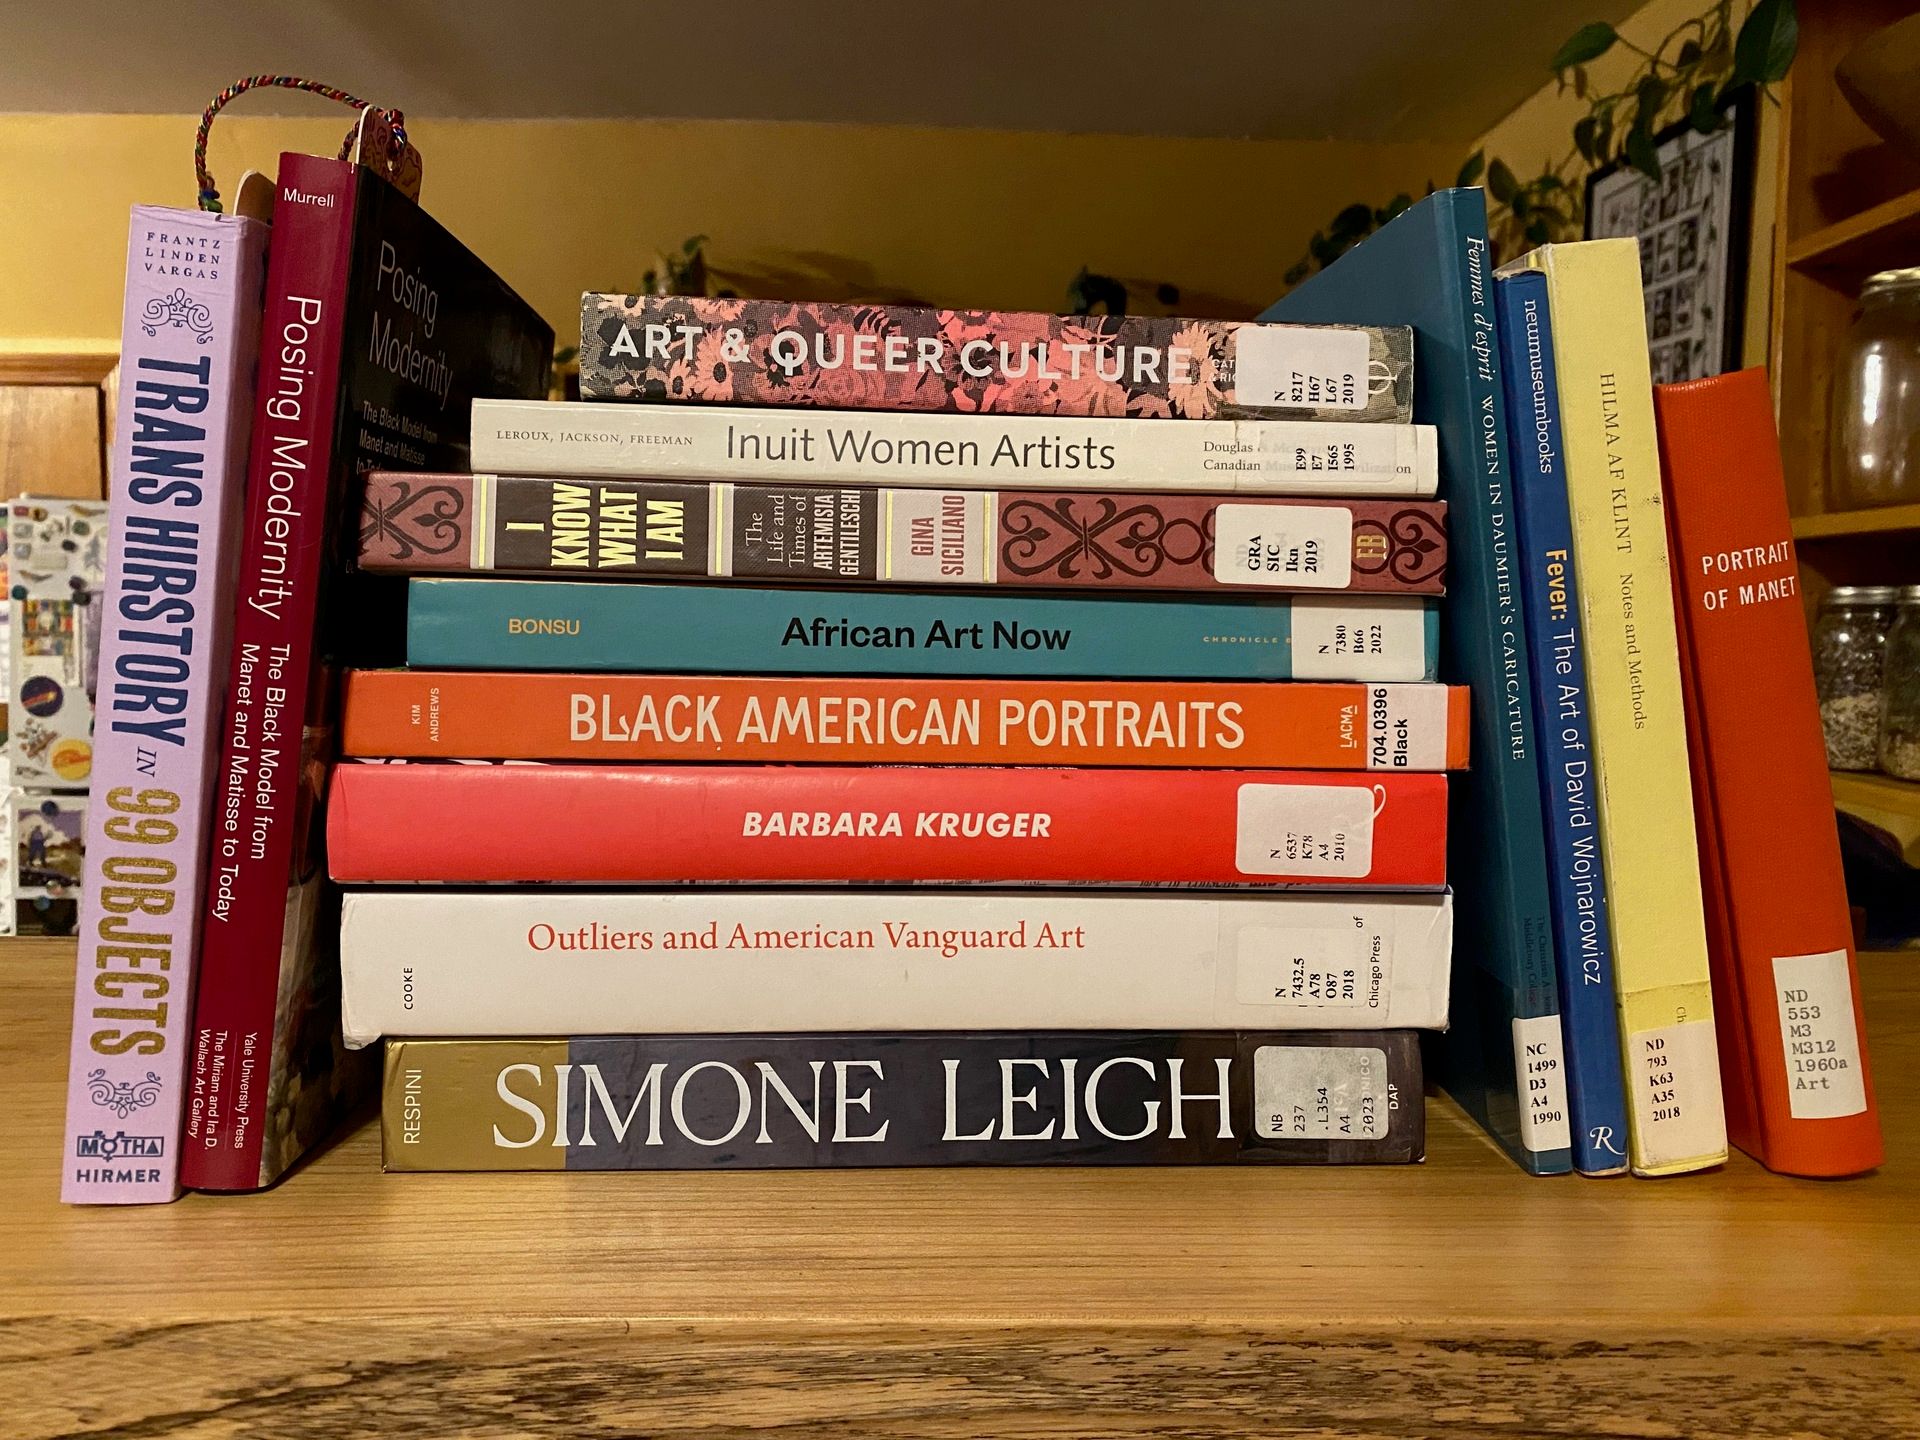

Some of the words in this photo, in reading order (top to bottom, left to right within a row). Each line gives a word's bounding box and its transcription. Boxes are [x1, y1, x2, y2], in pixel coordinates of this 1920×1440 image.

[284, 187, 334, 208] Murrell
[145, 247, 220, 265] LINDEN
[146, 231, 220, 250] FRANTZ
[144, 262, 219, 280] VARGAS
[1466, 236, 1484, 306] Femmes
[377, 240, 438, 338] Posing
[266, 295, 322, 421] Posing
[369, 311, 453, 411] Modernity
[609, 323, 702, 361] ART
[720, 328, 751, 362] &
[771, 331, 944, 376] QUEER
[961, 340, 1192, 384] CULTURE
[1472, 312, 1496, 382] d'esprit
[1291, 371, 1304, 402] 8217
[1308, 375, 1320, 403] H67
[1325, 378, 1337, 403] L67
[1343, 373, 1354, 404] 2019
[1525, 300, 1555, 474] newmuseumbooks
[1600, 372, 1621, 446] HILMA
[128, 356, 211, 507] TRANS
[496, 430, 554, 443] LEROUX,
[559, 432, 624, 446] JACKSON,
[630, 434, 693, 446] FREEMAN
[727, 425, 815, 462] Inuit
[827, 429, 979, 466] Women
[990, 434, 1116, 470] Artists
[1203, 441, 1254, 455] Douglas
[1481, 395, 1499, 475] WOMEN
[1203, 459, 1261, 471] Canadian
[1295, 447, 1307, 471] E99
[1311, 455, 1322, 471] E7
[1343, 443, 1355, 471] 1995
[1607, 454, 1625, 480] AF
[767, 494, 785, 525] and
[789, 494, 806, 512] of
[1489, 483, 1502, 505] IN
[248, 435, 309, 620] Modernity
[505, 522, 545, 532] I
[551, 482, 591, 567] KNOW
[598, 487, 638, 568] WHAT
[645, 500, 684, 545] AM
[745, 512, 763, 546] The
[813, 494, 834, 570] ARTEMISIA
[839, 489, 860, 576] GENTILESCHI
[911, 517, 934, 556] GINA
[941, 495, 965, 576] SICILIANO
[1611, 487, 1633, 554] KLINT
[645, 550, 684, 560] I
[766, 531, 784, 564] Life
[788, 517, 806, 567] Times
[1247, 535, 1262, 571] GRA
[1267, 544, 1280, 572] SIC
[1305, 540, 1318, 573] 2019
[1356, 535, 1387, 560] FB
[1702, 541, 1788, 575] PORTRAIT
[1492, 514, 1516, 625] DAUMIER'S
[1544, 549, 1568, 621] Fever:
[1619, 572, 1634, 620] Notes
[1704, 589, 1728, 610] OF
[1739, 576, 1795, 605] MANET
[111, 515, 200, 747] HIRSTORY
[508, 618, 580, 635] BONSU
[781, 617, 915, 648] African
[924, 619, 984, 649] Art
[993, 620, 1071, 651] Now
[1203, 636, 1278, 644] CHRONICLE
[1336, 625, 1346, 654] 7380
[1353, 629, 1364, 654] B66
[1371, 625, 1382, 654] 2022
[1625, 623, 1641, 656] and
[268, 643, 290, 680] The
[1553, 627, 1575, 675] The
[237, 643, 261, 706] Manet
[1502, 631, 1525, 761] CARICATURE
[1558, 683, 1580, 720] Art
[1627, 658, 1645, 730] Methods
[233, 711, 250, 750] and
[262, 687, 285, 742] Black
[412, 704, 420, 725] KIM
[430, 687, 439, 742] ANDREWS
[570, 693, 722, 744] BLACK
[736, 696, 980, 746] AMERICAN
[1000, 699, 1245, 750] PORTRAITS
[1340, 705, 1356, 748] LACMA
[1373, 688, 1387, 766] 704.0396
[1394, 718, 1408, 766] Black
[1562, 726, 1585, 752] of
[136, 746, 157, 778] IN
[225, 756, 249, 832] Matisse
[256, 749, 280, 811] Model
[1565, 760, 1592, 827] David
[103, 785, 181, 845] 99
[742, 812, 903, 837] BARBARA
[915, 812, 1052, 838] KRUGER
[222, 838, 239, 858] to
[250, 815, 272, 860] from
[1286, 832, 1297, 860] 6537
[1302, 835, 1313, 860] K78
[1318, 843, 1329, 861] A4
[1334, 833, 1345, 861] 2010
[212, 864, 239, 923] Today
[1353, 916, 1364, 928] of
[1571, 836, 1605, 986] Wojnarowicz
[527, 922, 654, 951] Outliers
[662, 921, 718, 950] and
[725, 922, 875, 950] American
[883, 921, 1027, 958] Vanguard
[1033, 923, 1086, 949] Art
[1371, 935, 1380, 963] Press
[90, 856, 178, 1058] OBJECTS
[403, 967, 413, 1010] COOKE
[1292, 958, 1305, 998] 7432.5
[1309, 973, 1321, 998] A78
[1343, 970, 1355, 999] 2018
[1369, 964, 1382, 1008] Chicago
[1784, 989, 1808, 1003] ND
[1788, 1006, 1821, 1020] 553
[214, 1030, 228, 1052] The
[244, 1032, 258, 1056] Yale
[1645, 1038, 1665, 1052] ND
[1790, 1024, 1812, 1037] M3
[197, 1029, 211, 1075] Wallach
[1526, 1042, 1547, 1057] NC
[1647, 1055, 1667, 1068] 793
[1792, 1040, 1836, 1055] M312
[210, 1055, 226, 1093] Miriam
[1528, 1059, 1557, 1074] 1499
[1649, 1072, 1674, 1087] K63
[1795, 1076, 1830, 1090] Art
[194, 1077, 206, 1095] Art
[234, 1059, 255, 1114] University
[1389, 1083, 1399, 1110] DAP
[1529, 1078, 1547, 1091] D3
[1651, 1089, 1675, 1105] A35
[188, 1097, 204, 1139] Gallery
[208, 1095, 220, 1118] and
[403, 1068, 422, 1145] RESPINI
[492, 1061, 890, 1148] SIMONE
[941, 1057, 1233, 1141] LEIGH
[1318, 1087, 1329, 1130] .L354
[1363, 1097, 1374, 1134] 2023
[1531, 1095, 1549, 1108] A4
[1532, 1110, 1562, 1125] 1990
[1653, 1106, 1681, 1121] 2018
[206, 1120, 219, 1135] Ira
[234, 1116, 249, 1149] Press
[1272, 1114, 1283, 1132] NB
[1294, 1105, 1305, 1132] 237
[1340, 1114, 1351, 1133] A4
[76, 1168, 161, 1185] HIRMER
